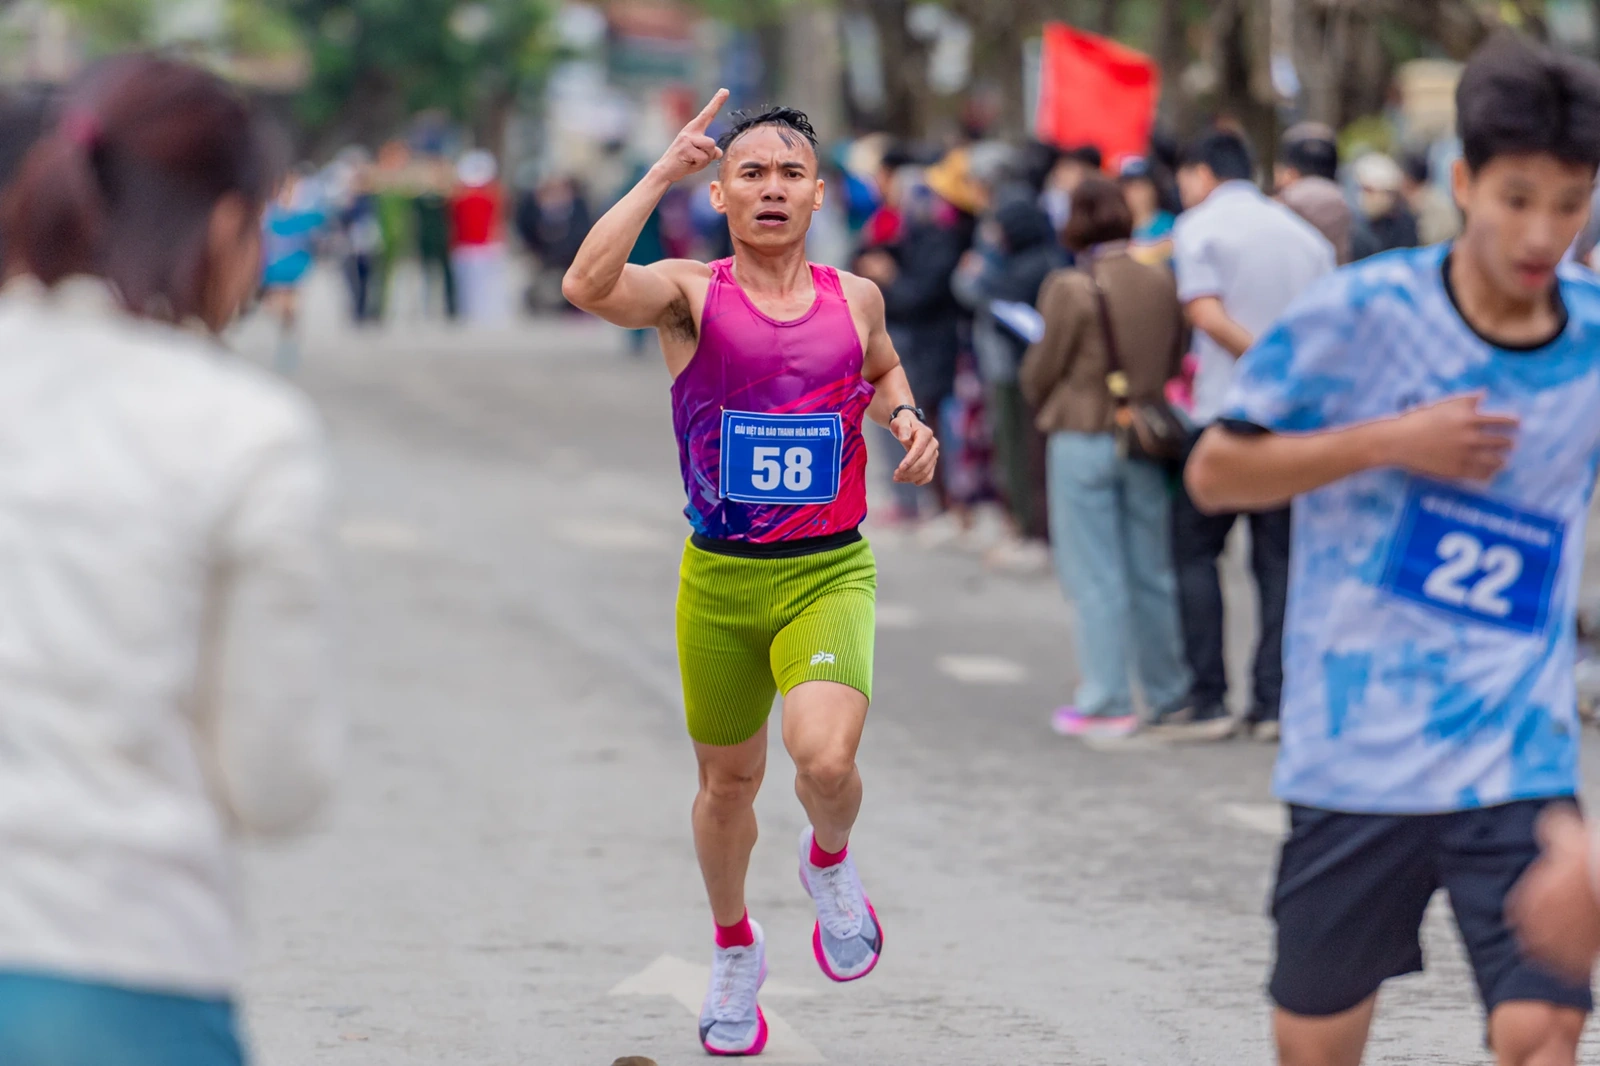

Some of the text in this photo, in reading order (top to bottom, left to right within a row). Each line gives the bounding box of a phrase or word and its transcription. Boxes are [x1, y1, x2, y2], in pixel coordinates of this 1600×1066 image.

[746, 425, 757, 437] VIỆT
[777, 428, 794, 436] THANH
[819, 427, 830, 436] 2025
[751, 446, 813, 492] 58
[1422, 531, 1523, 618] 22
